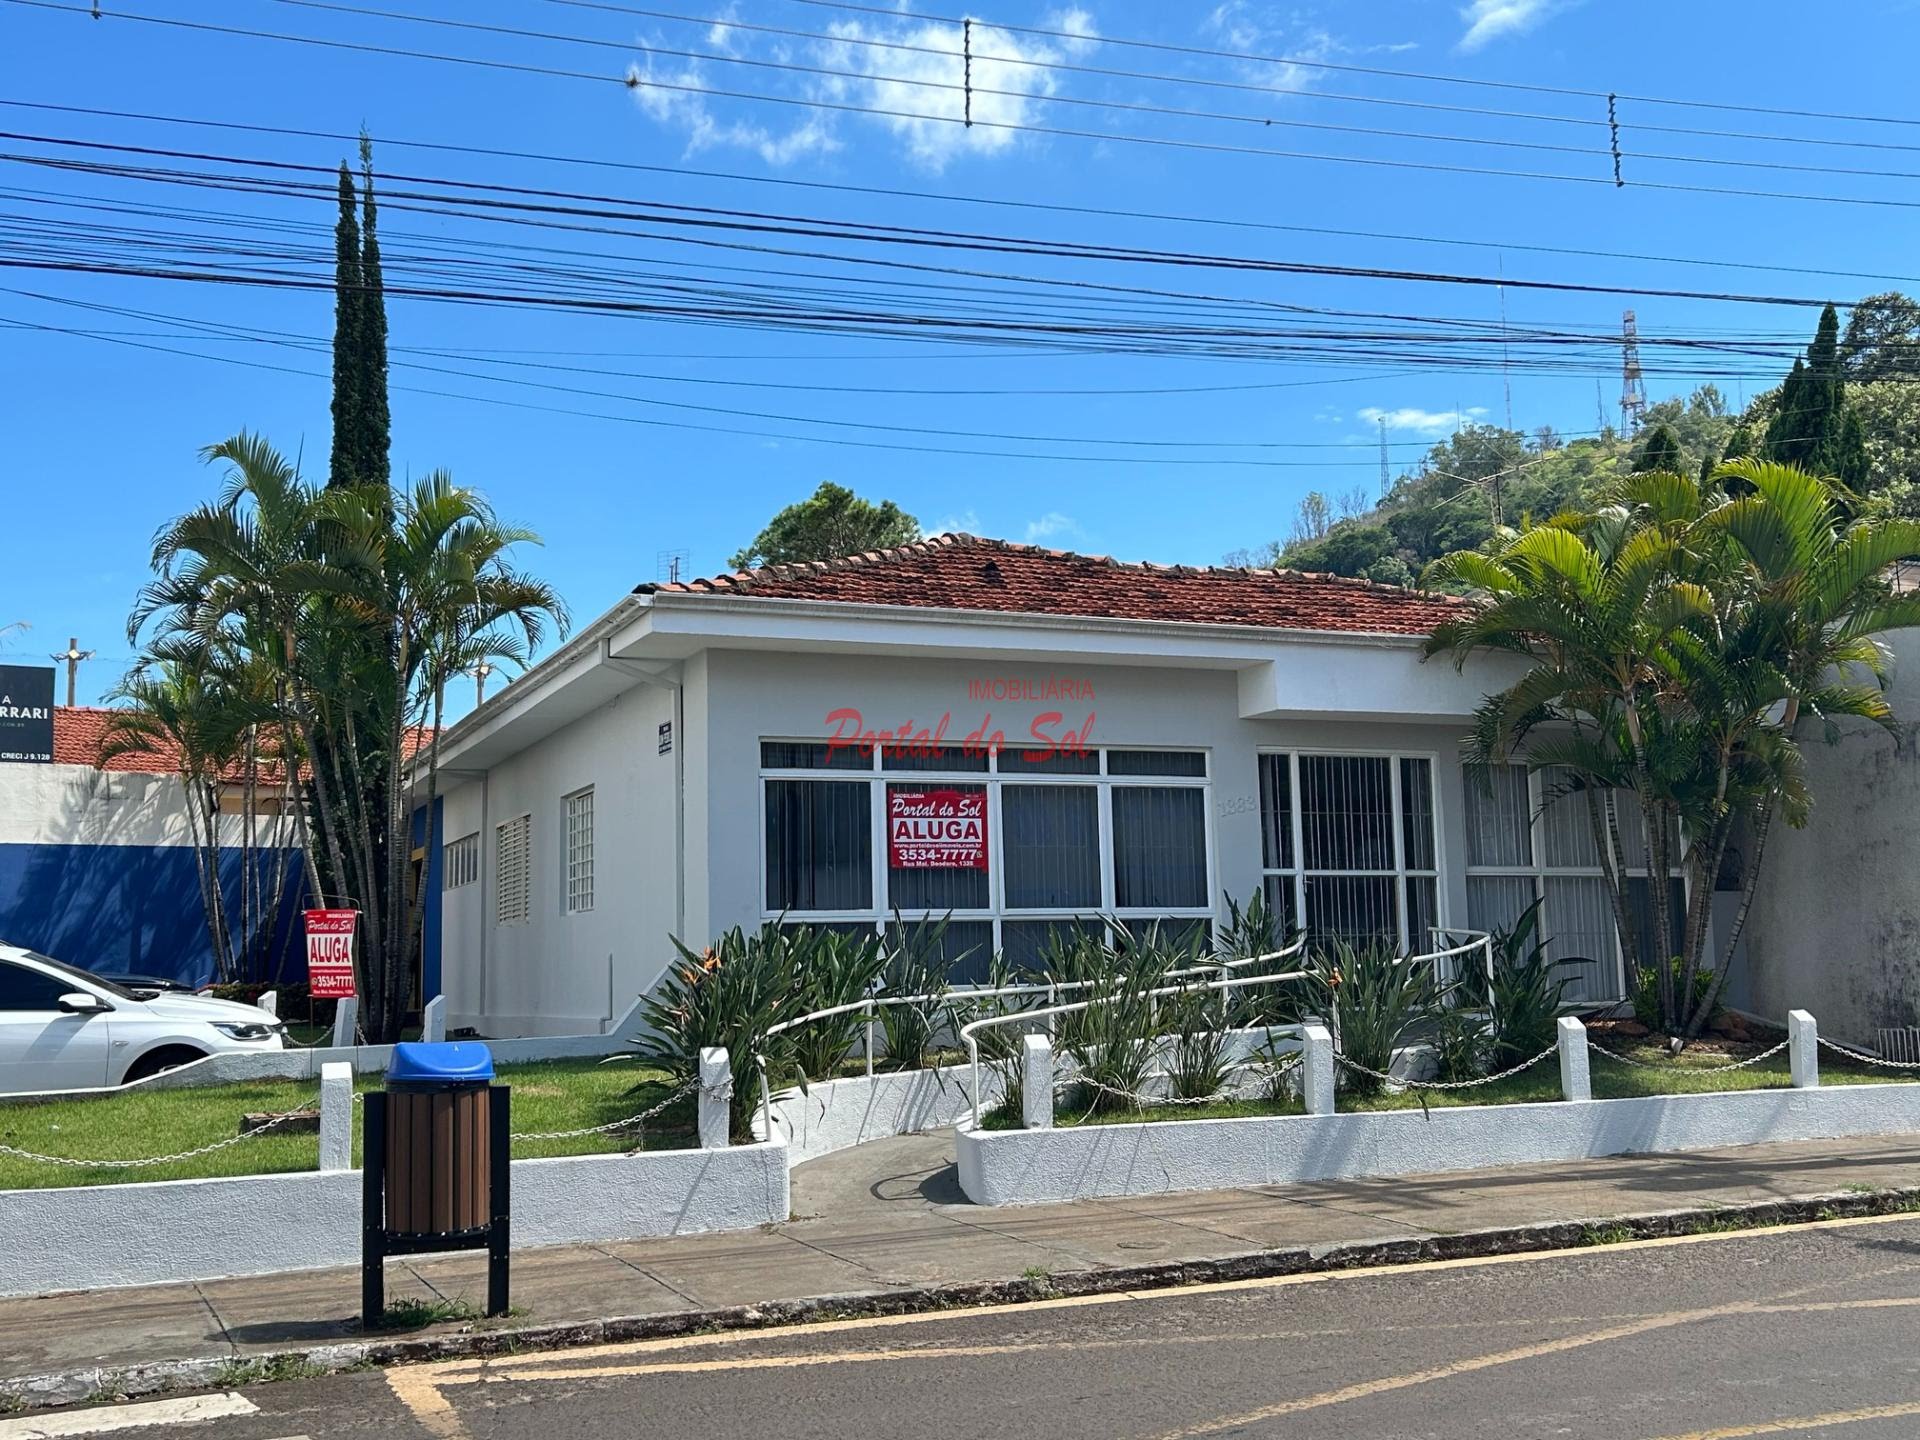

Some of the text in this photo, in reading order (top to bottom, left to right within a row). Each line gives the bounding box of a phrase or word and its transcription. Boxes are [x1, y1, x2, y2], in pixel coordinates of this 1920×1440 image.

[892, 798, 982, 817] Portal do Sol
[895, 821, 980, 840] ALUGA
[898, 849, 977, 860] 3534-7777
[310, 936, 350, 963] ALUGA
[317, 975, 352, 987] 3534-7777
